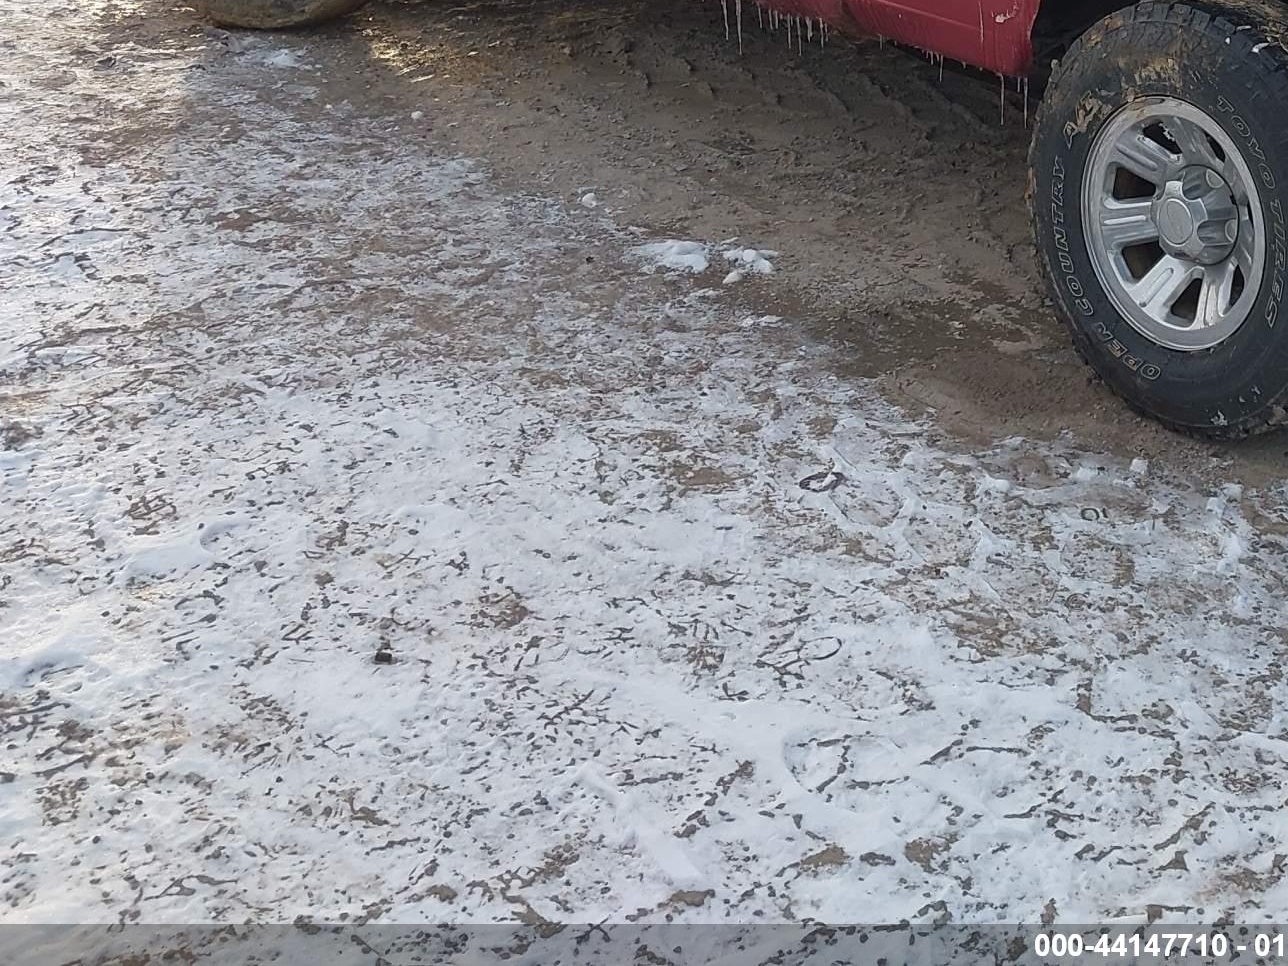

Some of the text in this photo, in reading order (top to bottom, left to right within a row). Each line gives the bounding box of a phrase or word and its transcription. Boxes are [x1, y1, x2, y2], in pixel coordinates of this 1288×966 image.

[1051, 155, 1094, 316] COUNTRY
[1217, 95, 1287, 328] TOYO TIRES
[1097, 321, 1161, 380] OPEN
